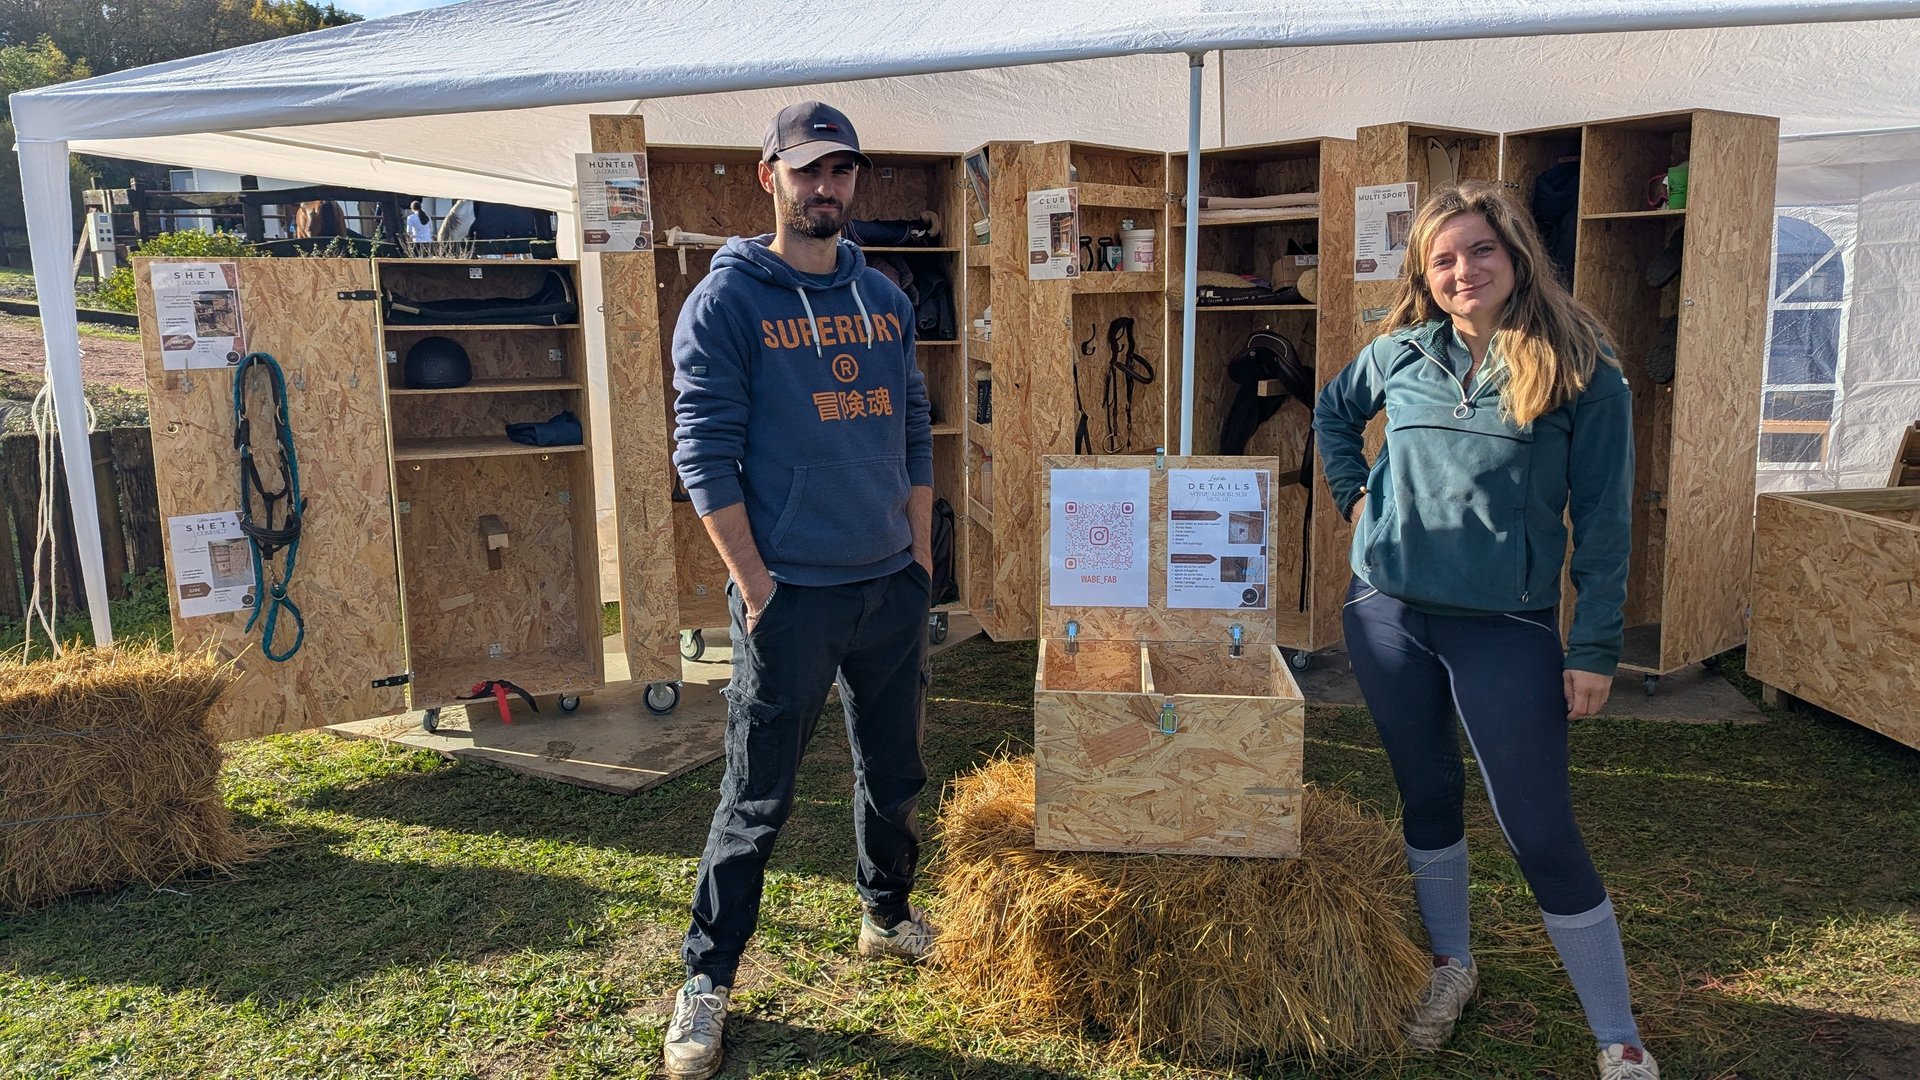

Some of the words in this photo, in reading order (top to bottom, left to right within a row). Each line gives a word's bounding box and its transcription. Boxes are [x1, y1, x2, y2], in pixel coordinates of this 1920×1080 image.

[1382, 191, 1407, 200] SPORT
[1039, 196, 1065, 205] CLUB
[173, 271, 215, 279] SHET
[761, 312, 902, 349] SUPERDRY
[812, 386, 893, 422] 冒険魂
[1080, 575, 1117, 584] WABE_FAB
